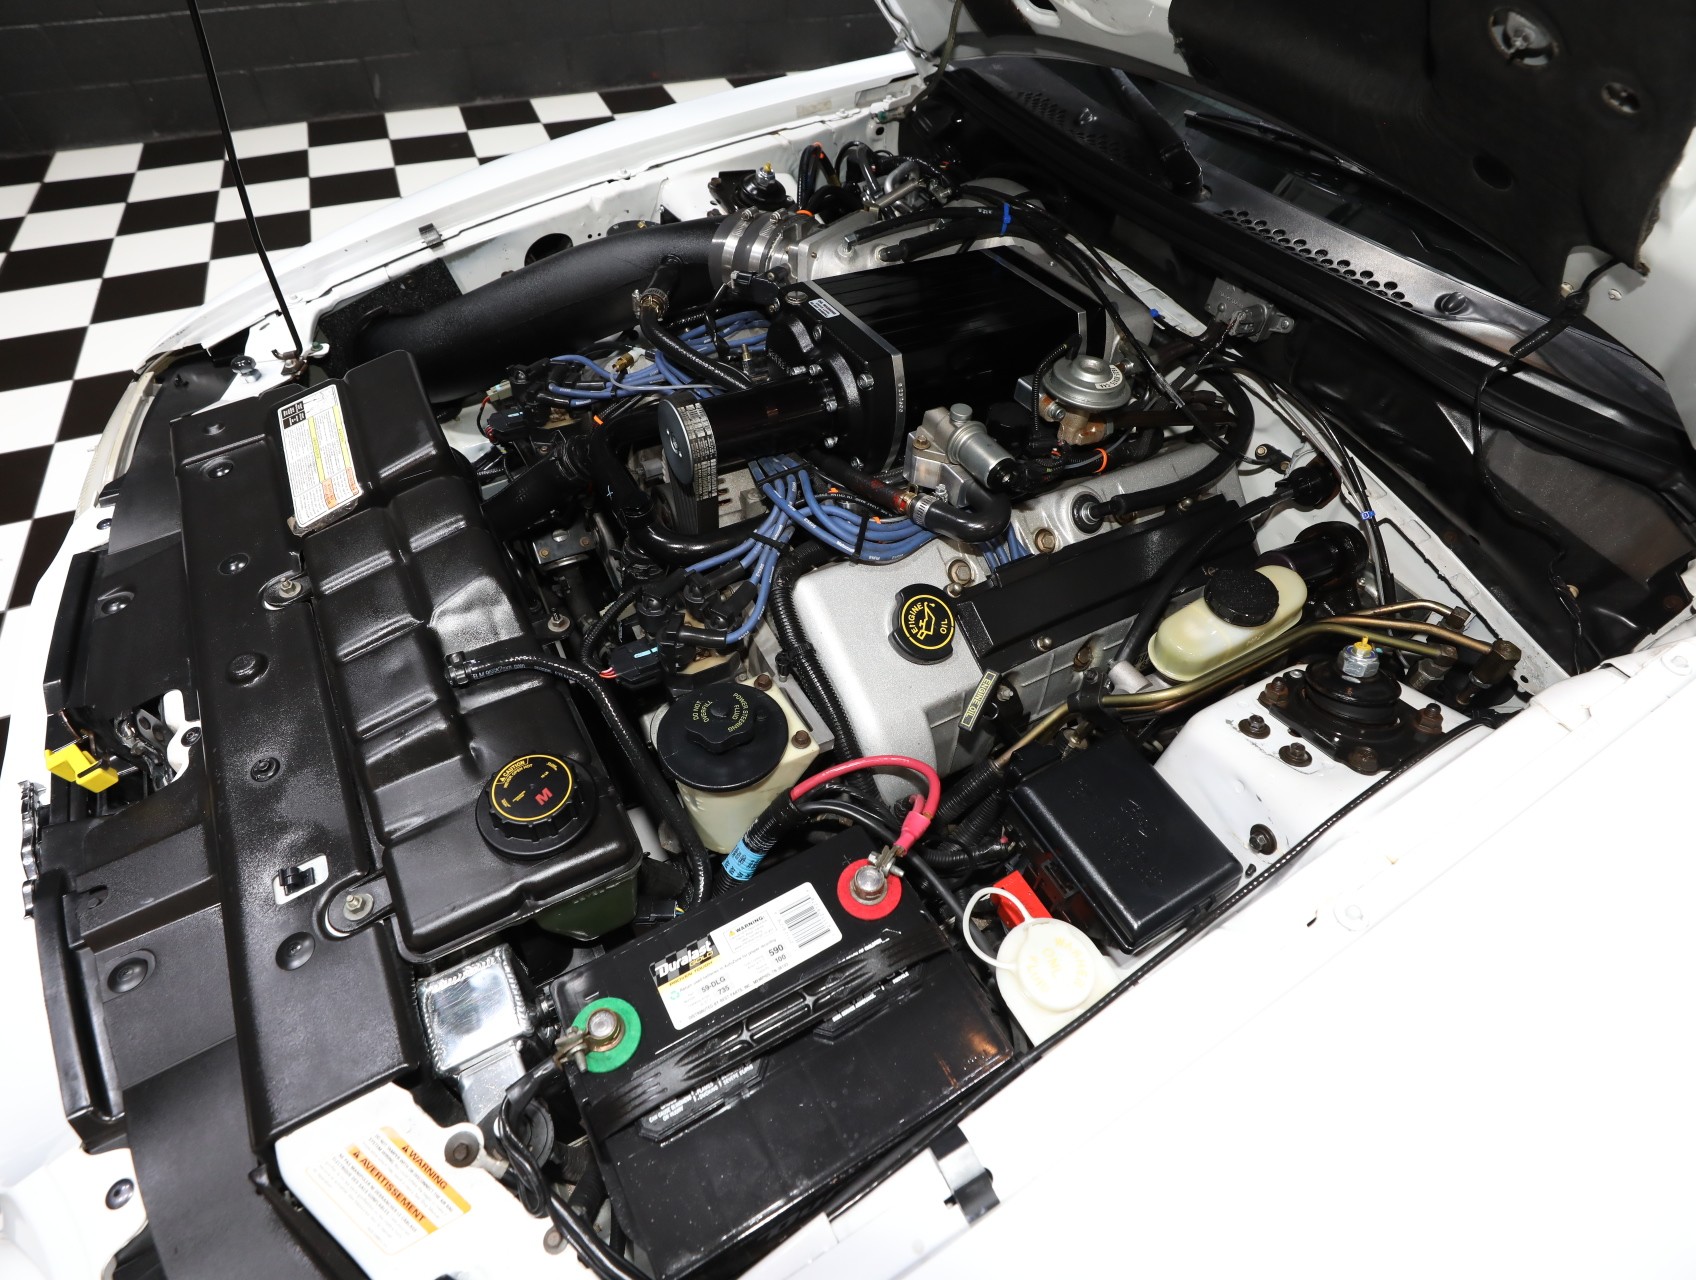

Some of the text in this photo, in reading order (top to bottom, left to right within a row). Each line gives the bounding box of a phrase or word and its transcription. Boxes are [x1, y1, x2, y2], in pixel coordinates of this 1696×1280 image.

[940, 618, 948, 634] OIL
[966, 678, 991, 717] ENGINE OIL
[692, 700, 701, 721] DO NOT
[700, 700, 713, 723] OVERFILL
[727, 692, 749, 733] POWER STEERING
[732, 704, 741, 720] FLUID
[503, 760, 526, 777] CAUTION
[534, 786, 553, 805] M
[654, 939, 712, 977] Duralast
[688, 950, 713, 966] GOLD
[767, 943, 784, 957] 590
[774, 953, 787, 964] 100
[700, 975, 726, 993] 59-DLG
[717, 984, 730, 995] 735
[407, 1149, 448, 1190] WARNING
[358, 1156, 426, 1222] AVERTISSEMENT
